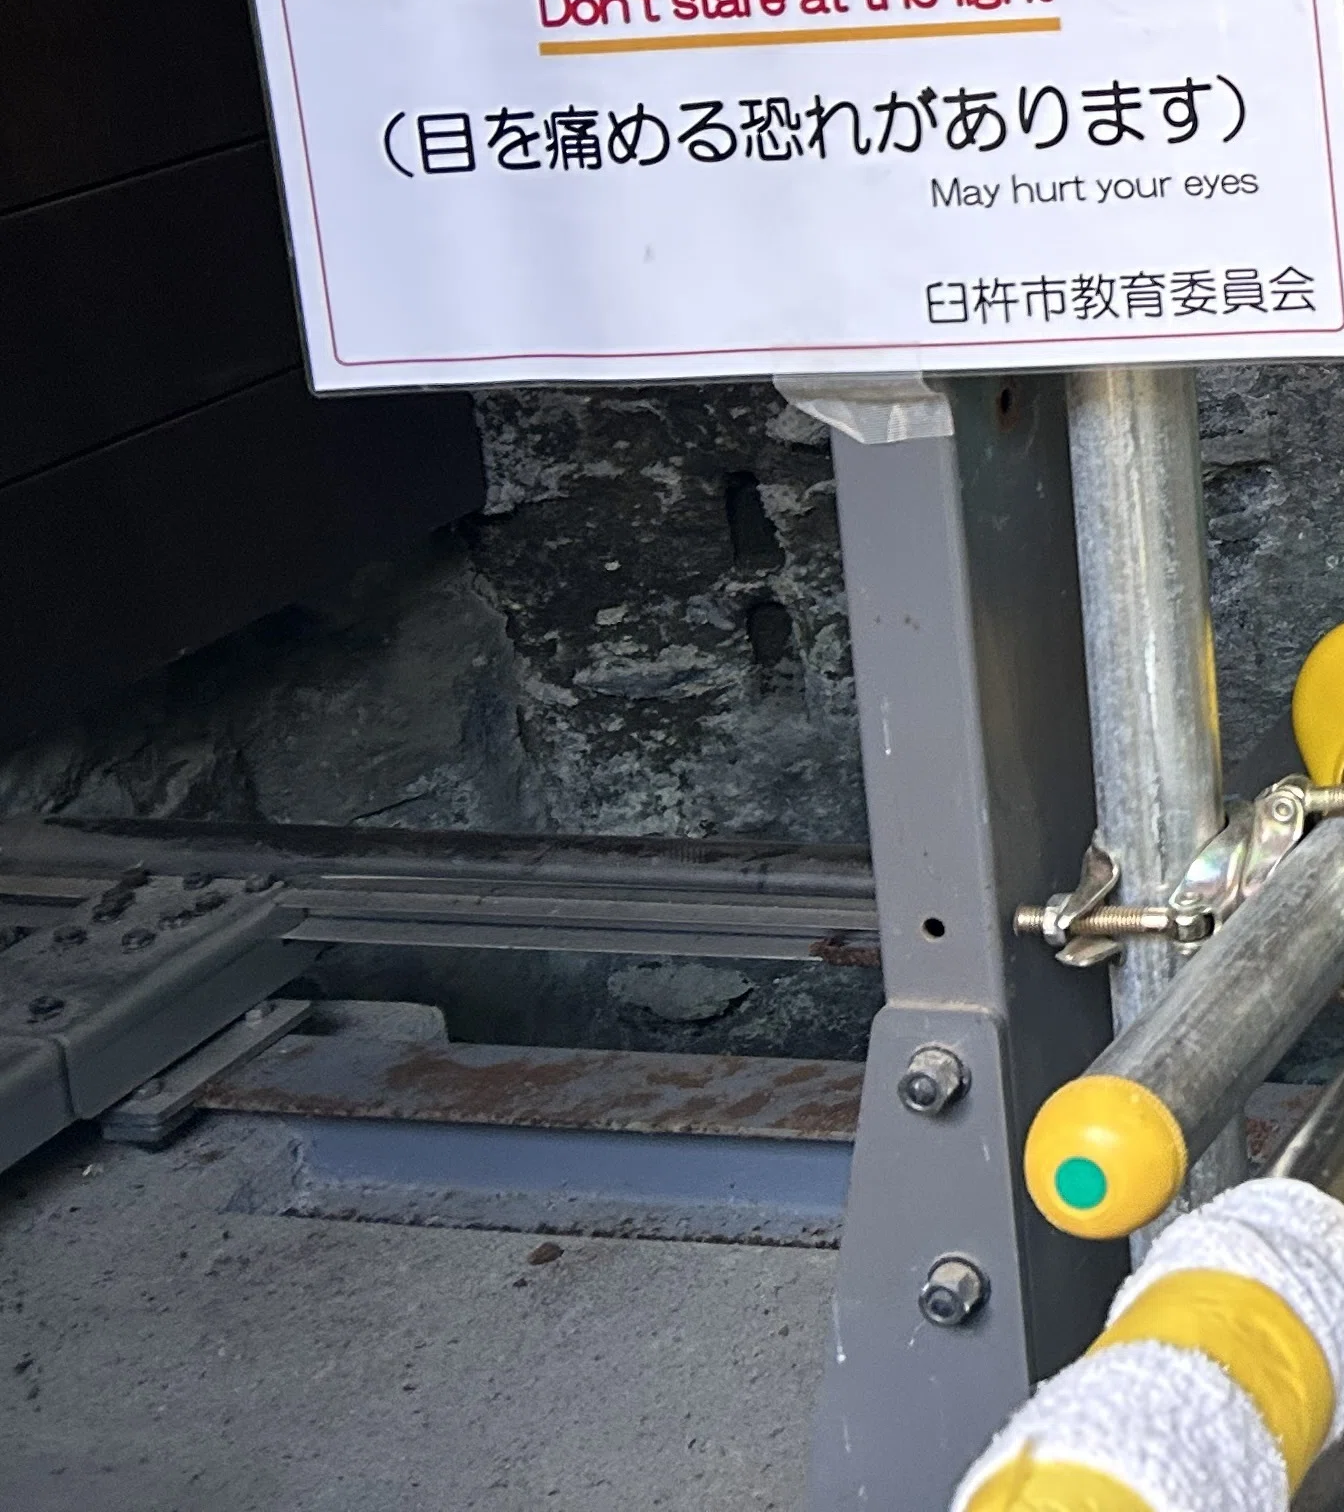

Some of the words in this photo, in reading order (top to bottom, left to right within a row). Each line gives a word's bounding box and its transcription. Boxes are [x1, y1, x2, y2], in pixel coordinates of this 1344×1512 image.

[930, 176, 1002, 210] May
[1010, 172, 1088, 205] hurt
[1094, 176, 1174, 208] your
[1182, 172, 1261, 204] eyes
[924, 264, 1318, 326] 臼杵市教育委員会
